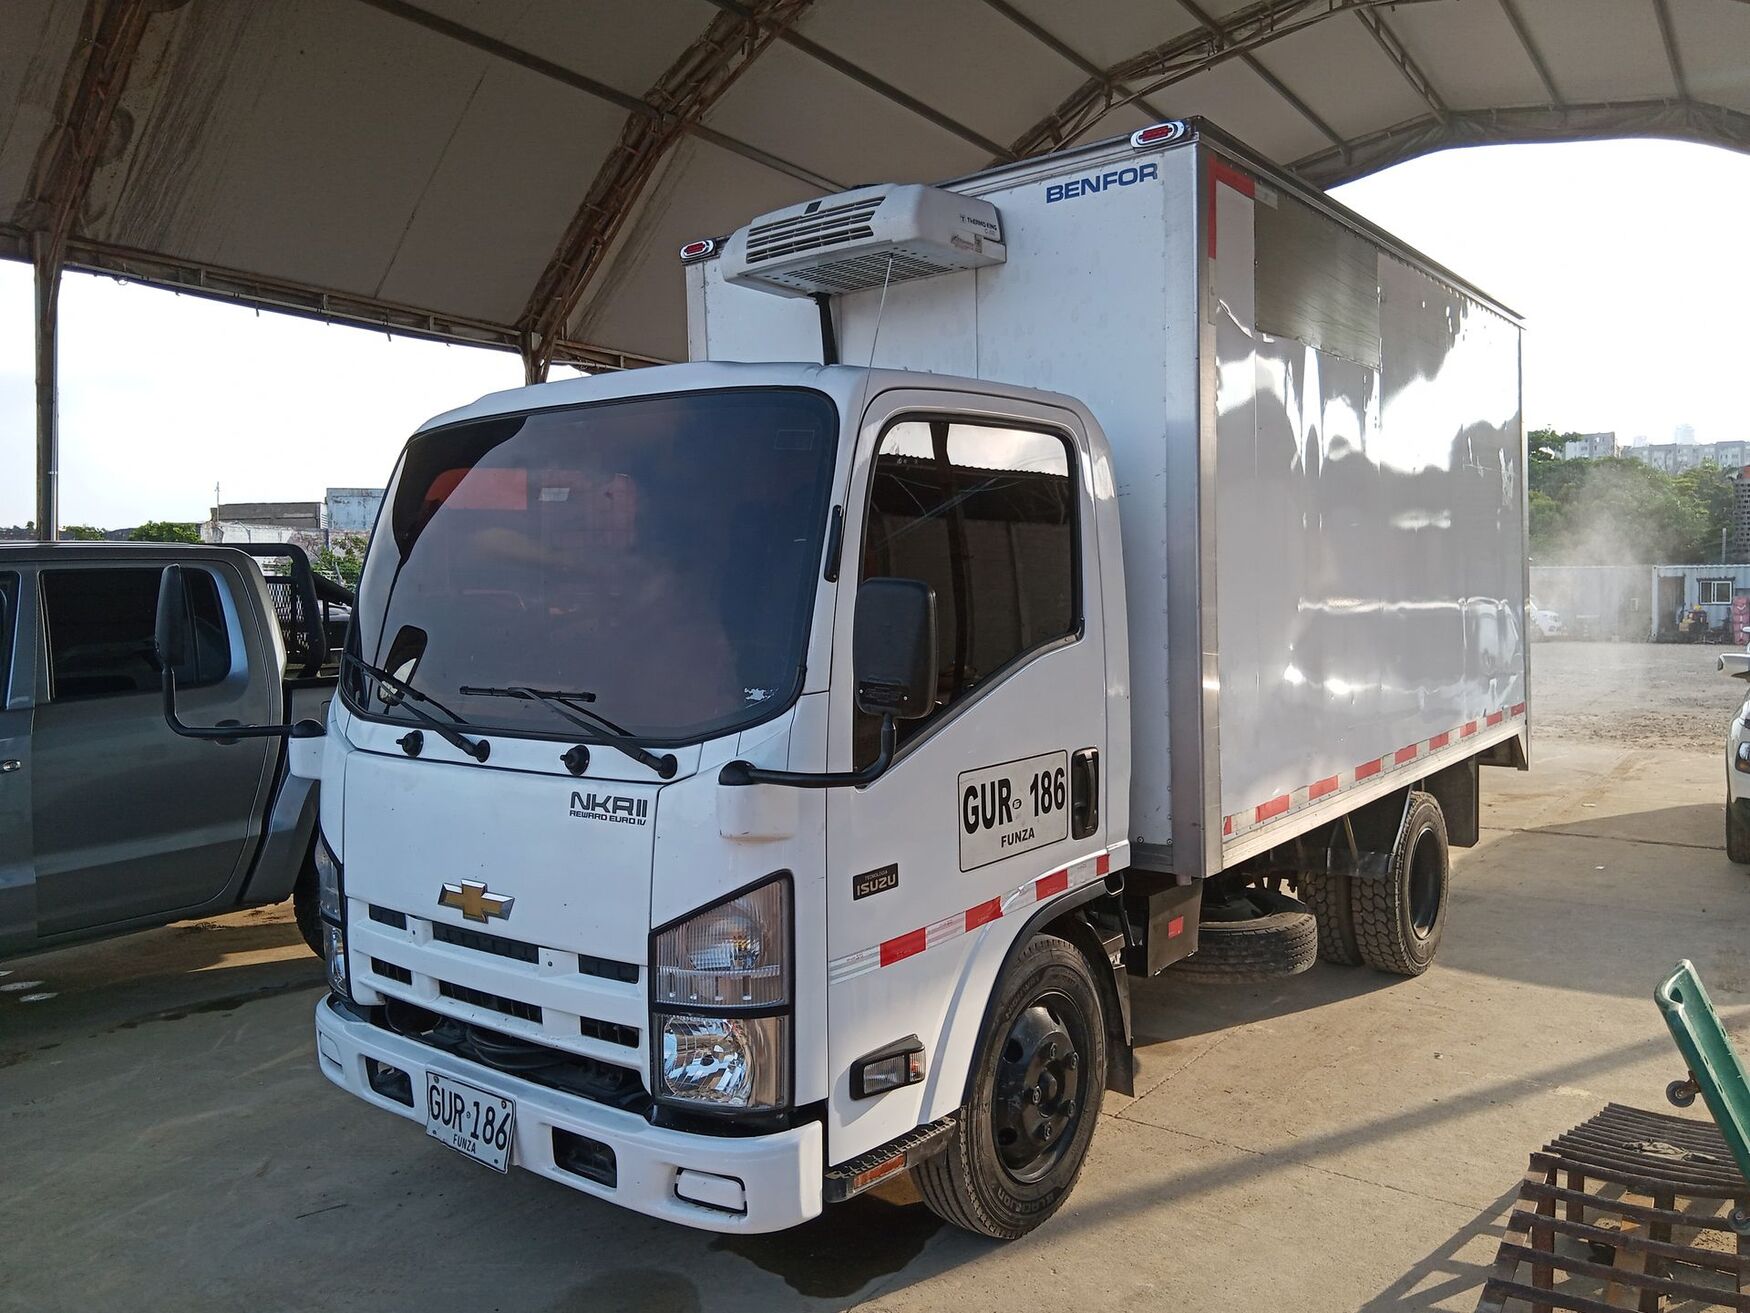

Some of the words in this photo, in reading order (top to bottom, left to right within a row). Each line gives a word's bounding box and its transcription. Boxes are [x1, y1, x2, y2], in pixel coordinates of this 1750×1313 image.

[1046, 163, 1159, 204] BENFOR
[963, 778, 1013, 835] GUR
[1029, 767, 1066, 818] 186
[569, 810, 607, 821] REWARD
[609, 815, 635, 825] EURO
[1001, 827, 1035, 848] FUNZA
[857, 873, 896, 896] ISUZU
[429, 1084, 465, 1133] GUR
[470, 1101, 511, 1151] 186
[453, 1134, 476, 1154] FUNZA
